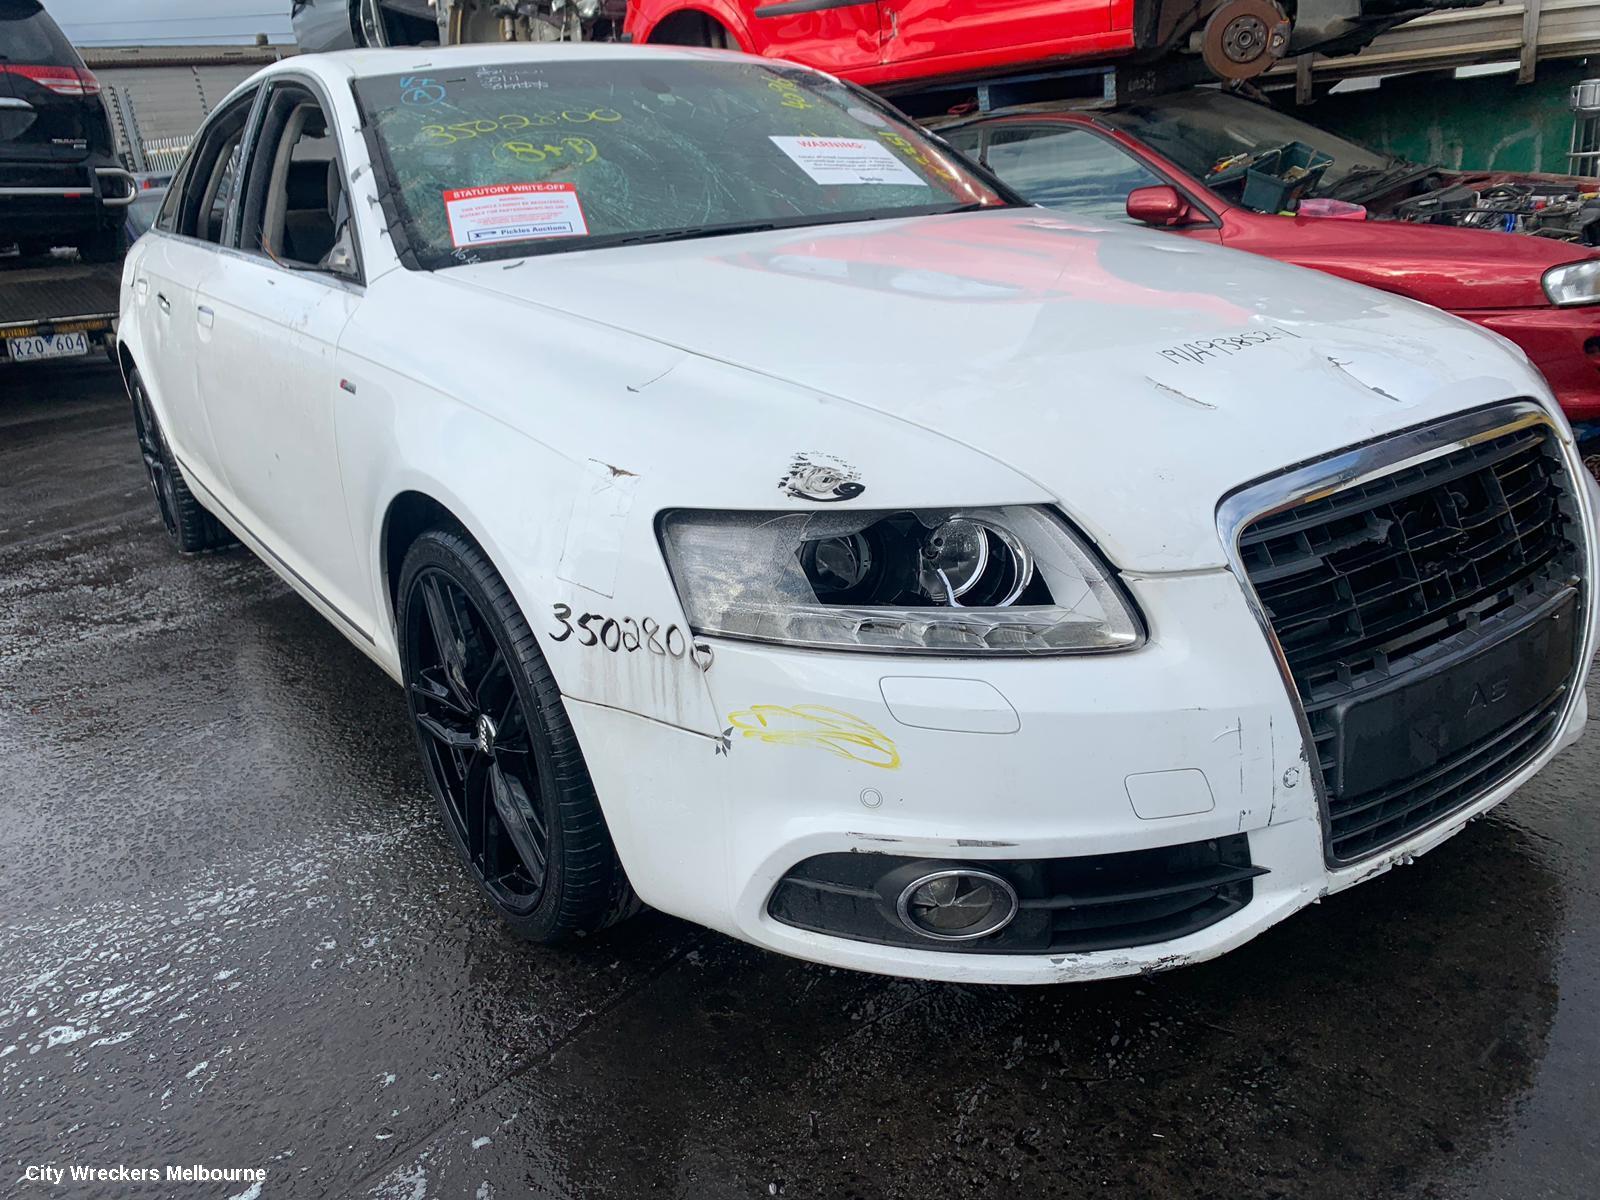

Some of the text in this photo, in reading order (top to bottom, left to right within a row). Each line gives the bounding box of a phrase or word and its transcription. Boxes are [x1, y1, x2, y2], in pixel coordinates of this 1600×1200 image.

[453, 184, 566, 199] STATUTORY WRITE-OFF
[500, 224, 567, 236] Pickles Auctions
[14, 333, 85, 356] X20 604
